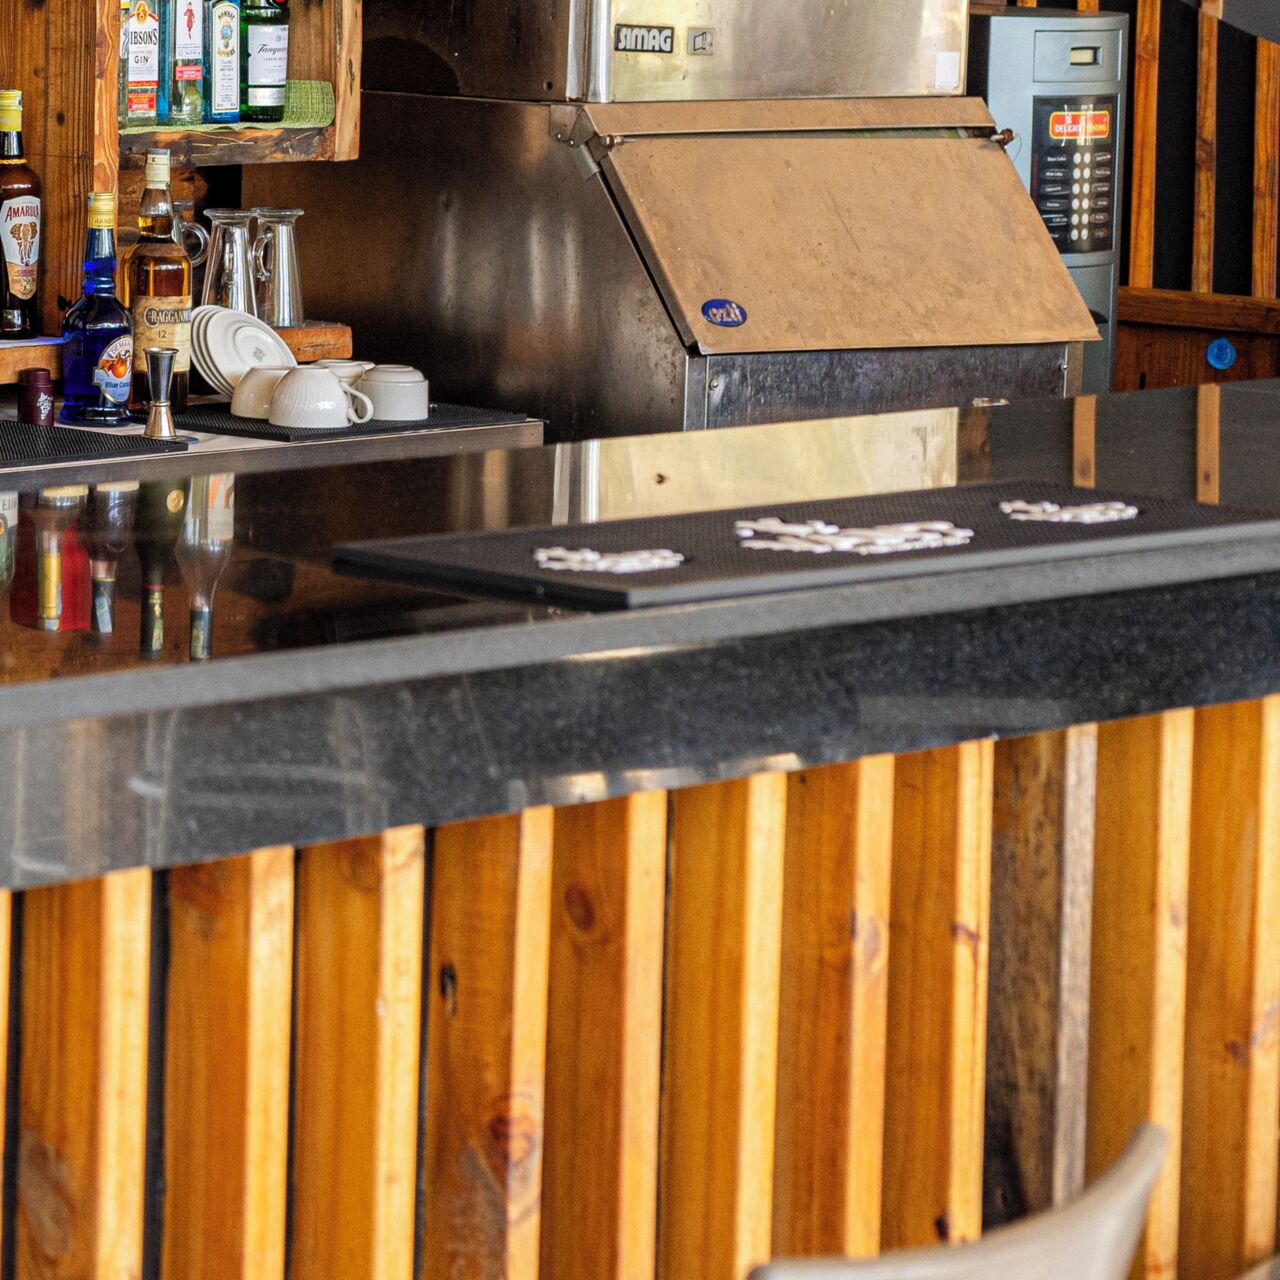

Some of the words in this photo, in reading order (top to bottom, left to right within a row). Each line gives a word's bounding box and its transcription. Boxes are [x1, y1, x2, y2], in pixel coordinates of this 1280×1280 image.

[618, 28, 672, 51] SIMAG
[134, 56, 149, 64] GIN
[158, 330, 166, 338] 12
[105, 381, 118, 389] Blue
